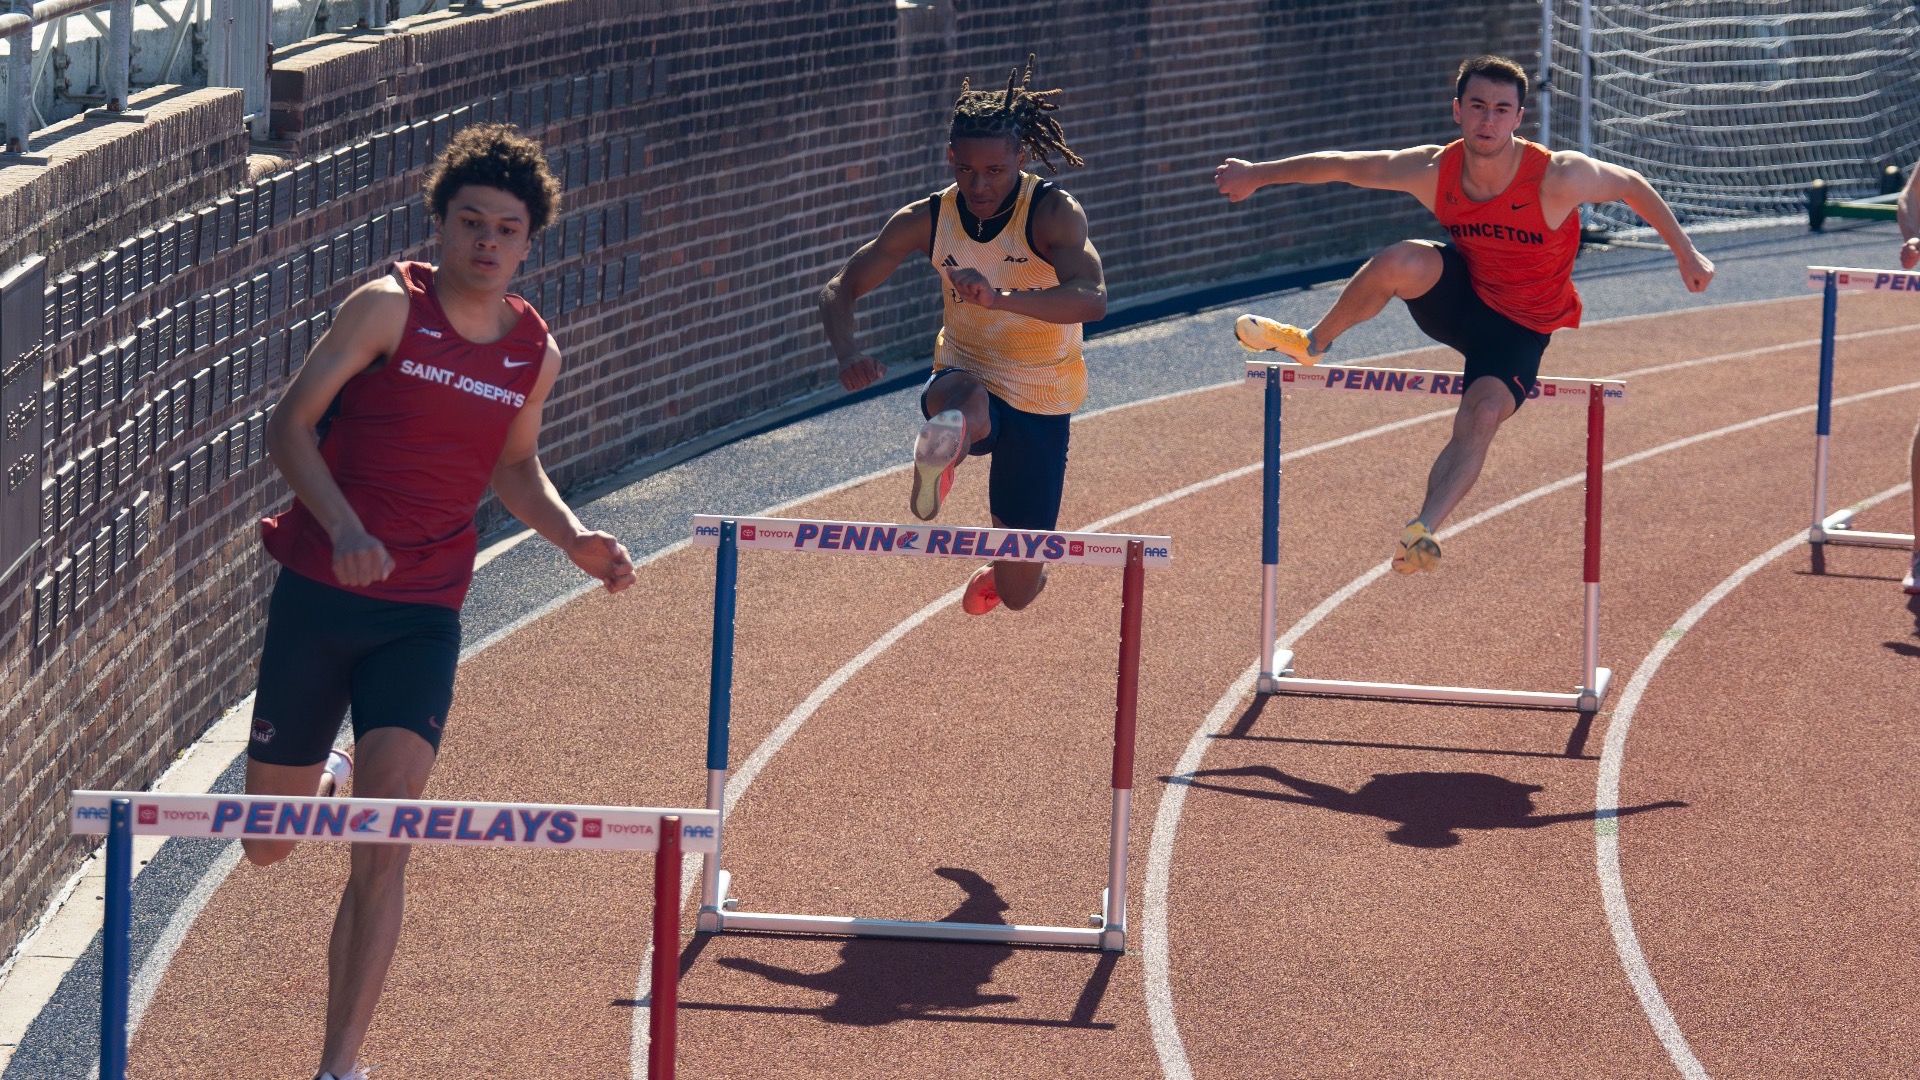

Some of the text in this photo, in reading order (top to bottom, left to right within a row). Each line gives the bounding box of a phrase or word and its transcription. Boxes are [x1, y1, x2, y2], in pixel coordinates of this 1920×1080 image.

[400, 360, 526, 408] SAINT JOSEPH'S
[1325, 369, 1407, 391] PENN
[1430, 374, 1541, 399] RES
[759, 530, 794, 539] TOYOTA
[795, 523, 898, 551] PENN
[926, 530, 1067, 560] RELAYS
[1087, 545, 1122, 554] TOYOTA
[163, 810, 210, 821] TOYOTA
[211, 801, 350, 836] PENN
[389, 805, 577, 844] RELAYS
[607, 823, 654, 835] TOYOTA
